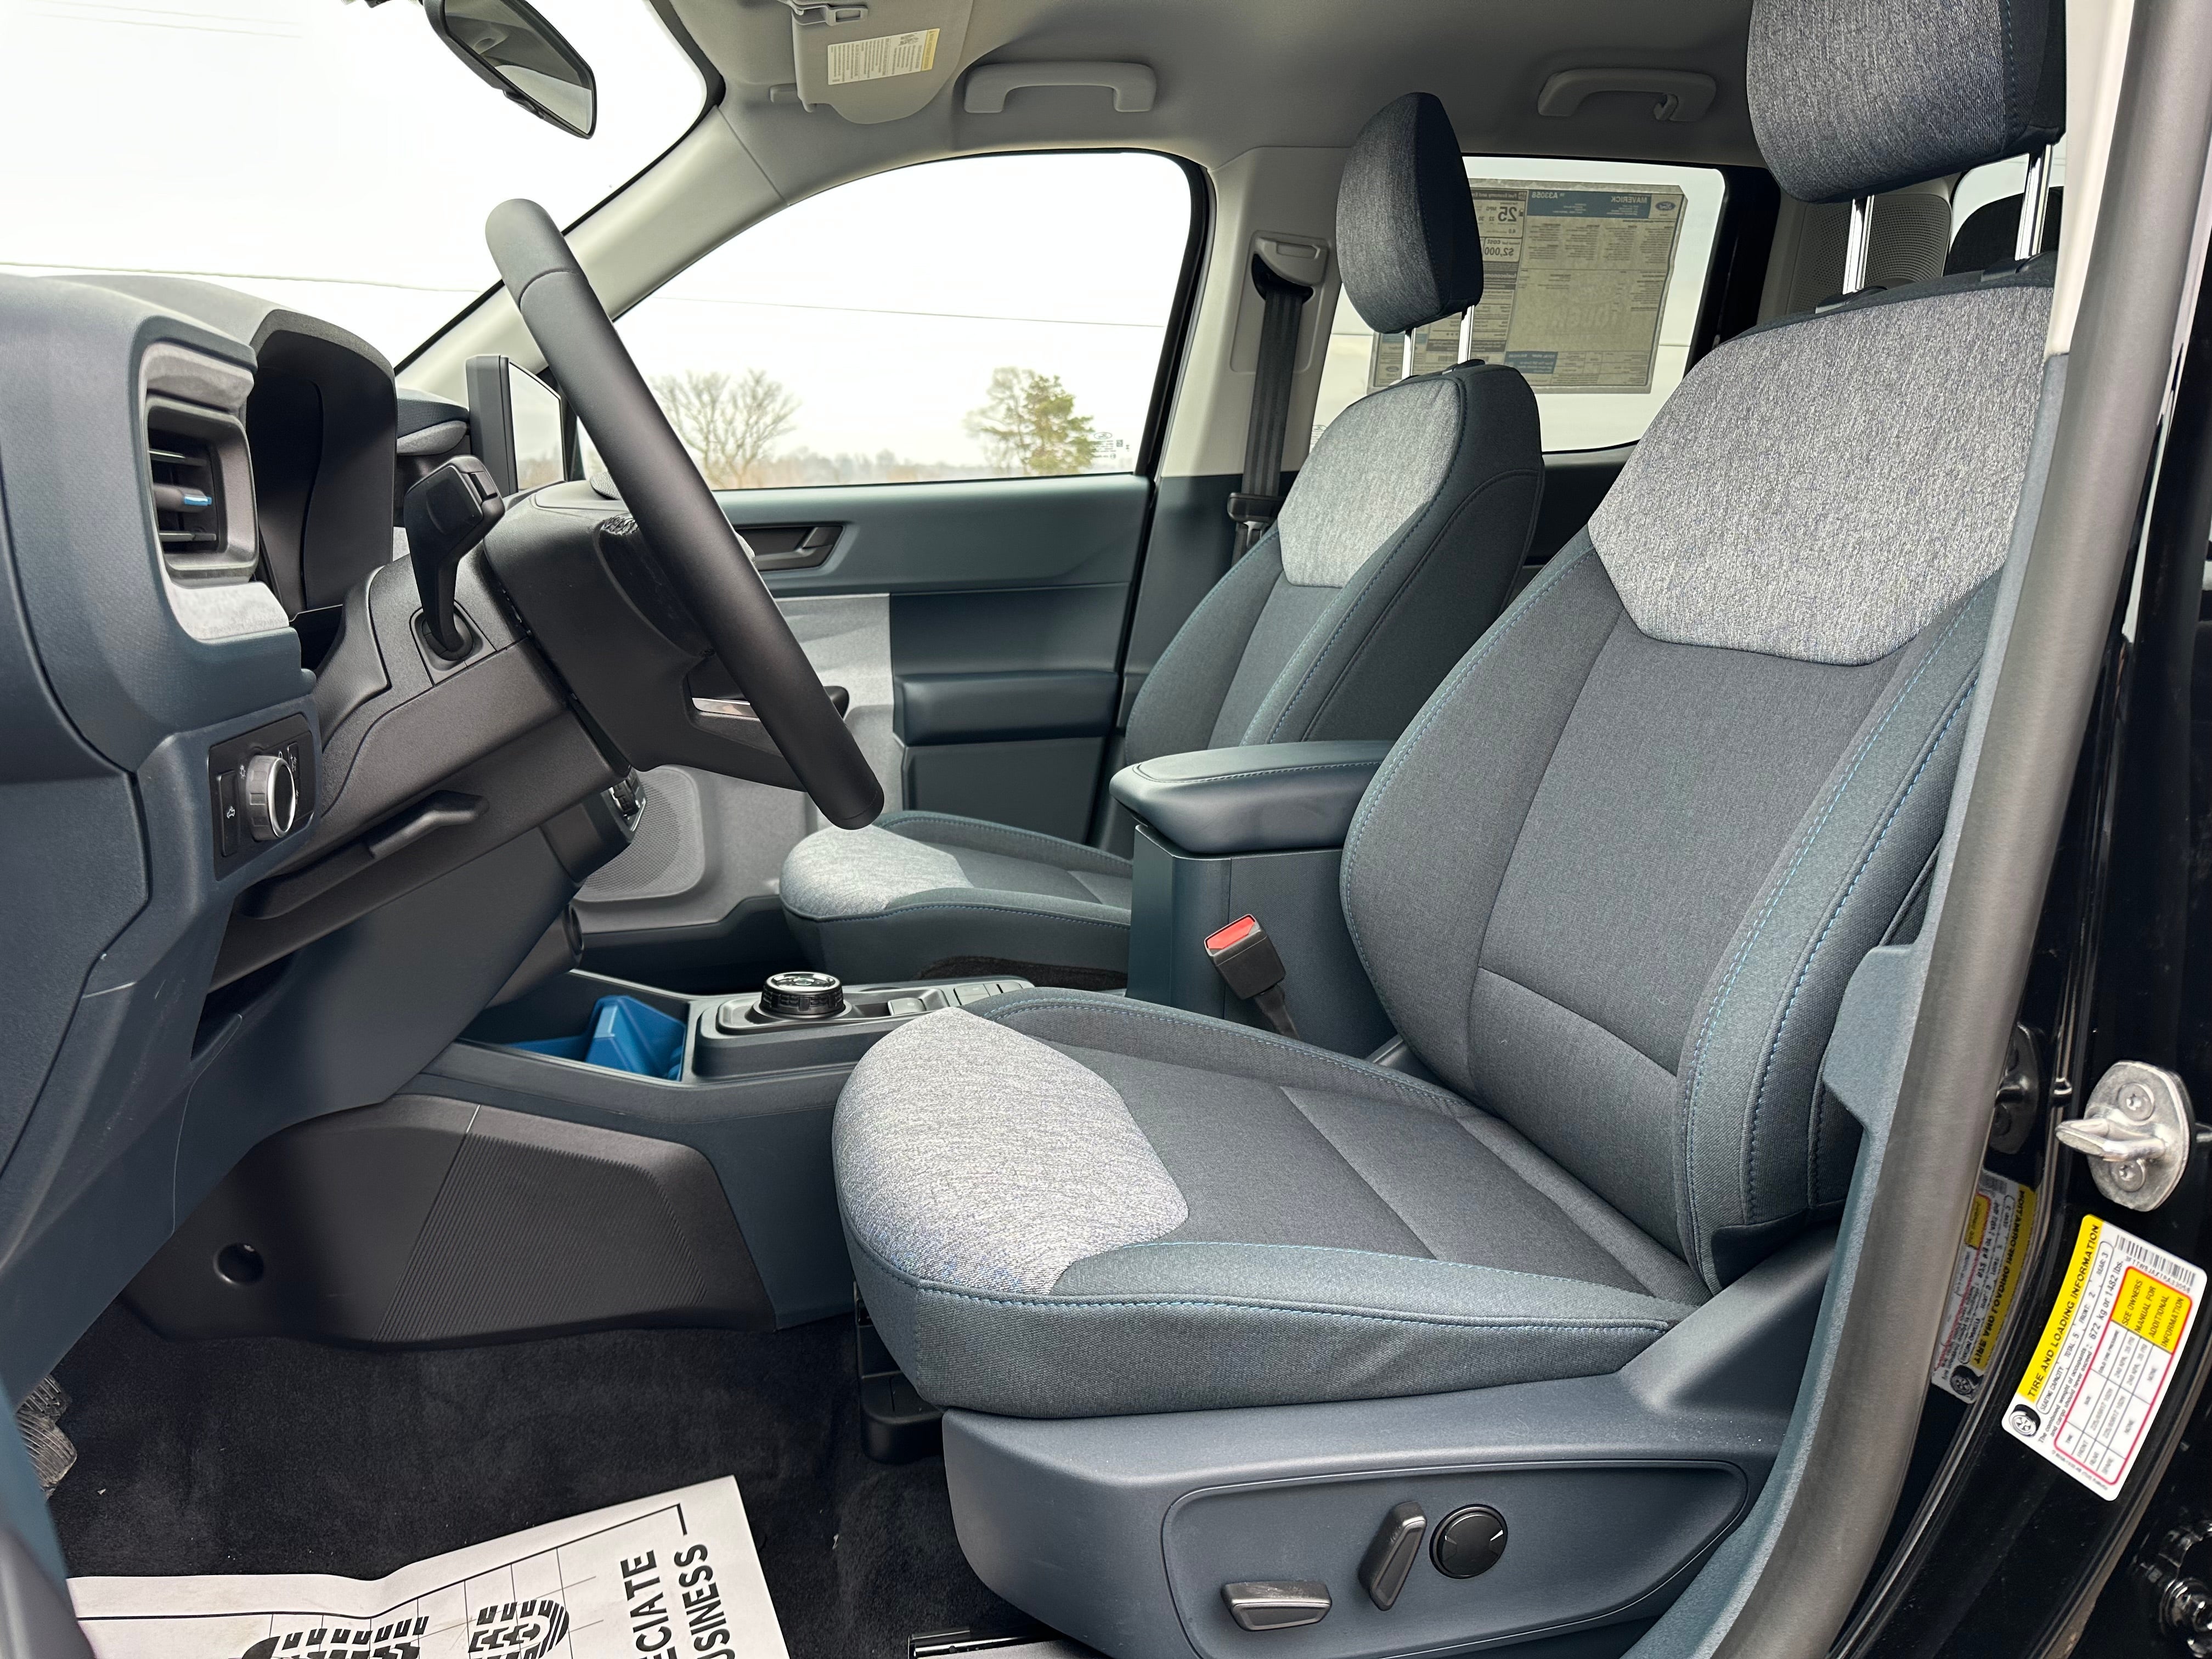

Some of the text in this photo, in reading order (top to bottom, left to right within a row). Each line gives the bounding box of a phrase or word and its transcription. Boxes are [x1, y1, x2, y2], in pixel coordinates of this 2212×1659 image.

[2102, 1297, 2111, 1308] or
[2104, 1274, 2118, 1296] 1482
[2121, 1279, 2143, 1326] SEE OWNERS
[2027, 1223, 2100, 1398] TIRE AND LOADING INFORMATION
[2089, 1322, 2101, 1340] 672
[2096, 1308, 2108, 1321] kg
[2134, 1285, 2156, 1333] MANUAL FOR
[2148, 1293, 2170, 1338] ADDITIONAL
[2160, 1296, 2185, 1347] INFORMATION
[2039, 1365, 2064, 1411] SEATING CAPACITY
